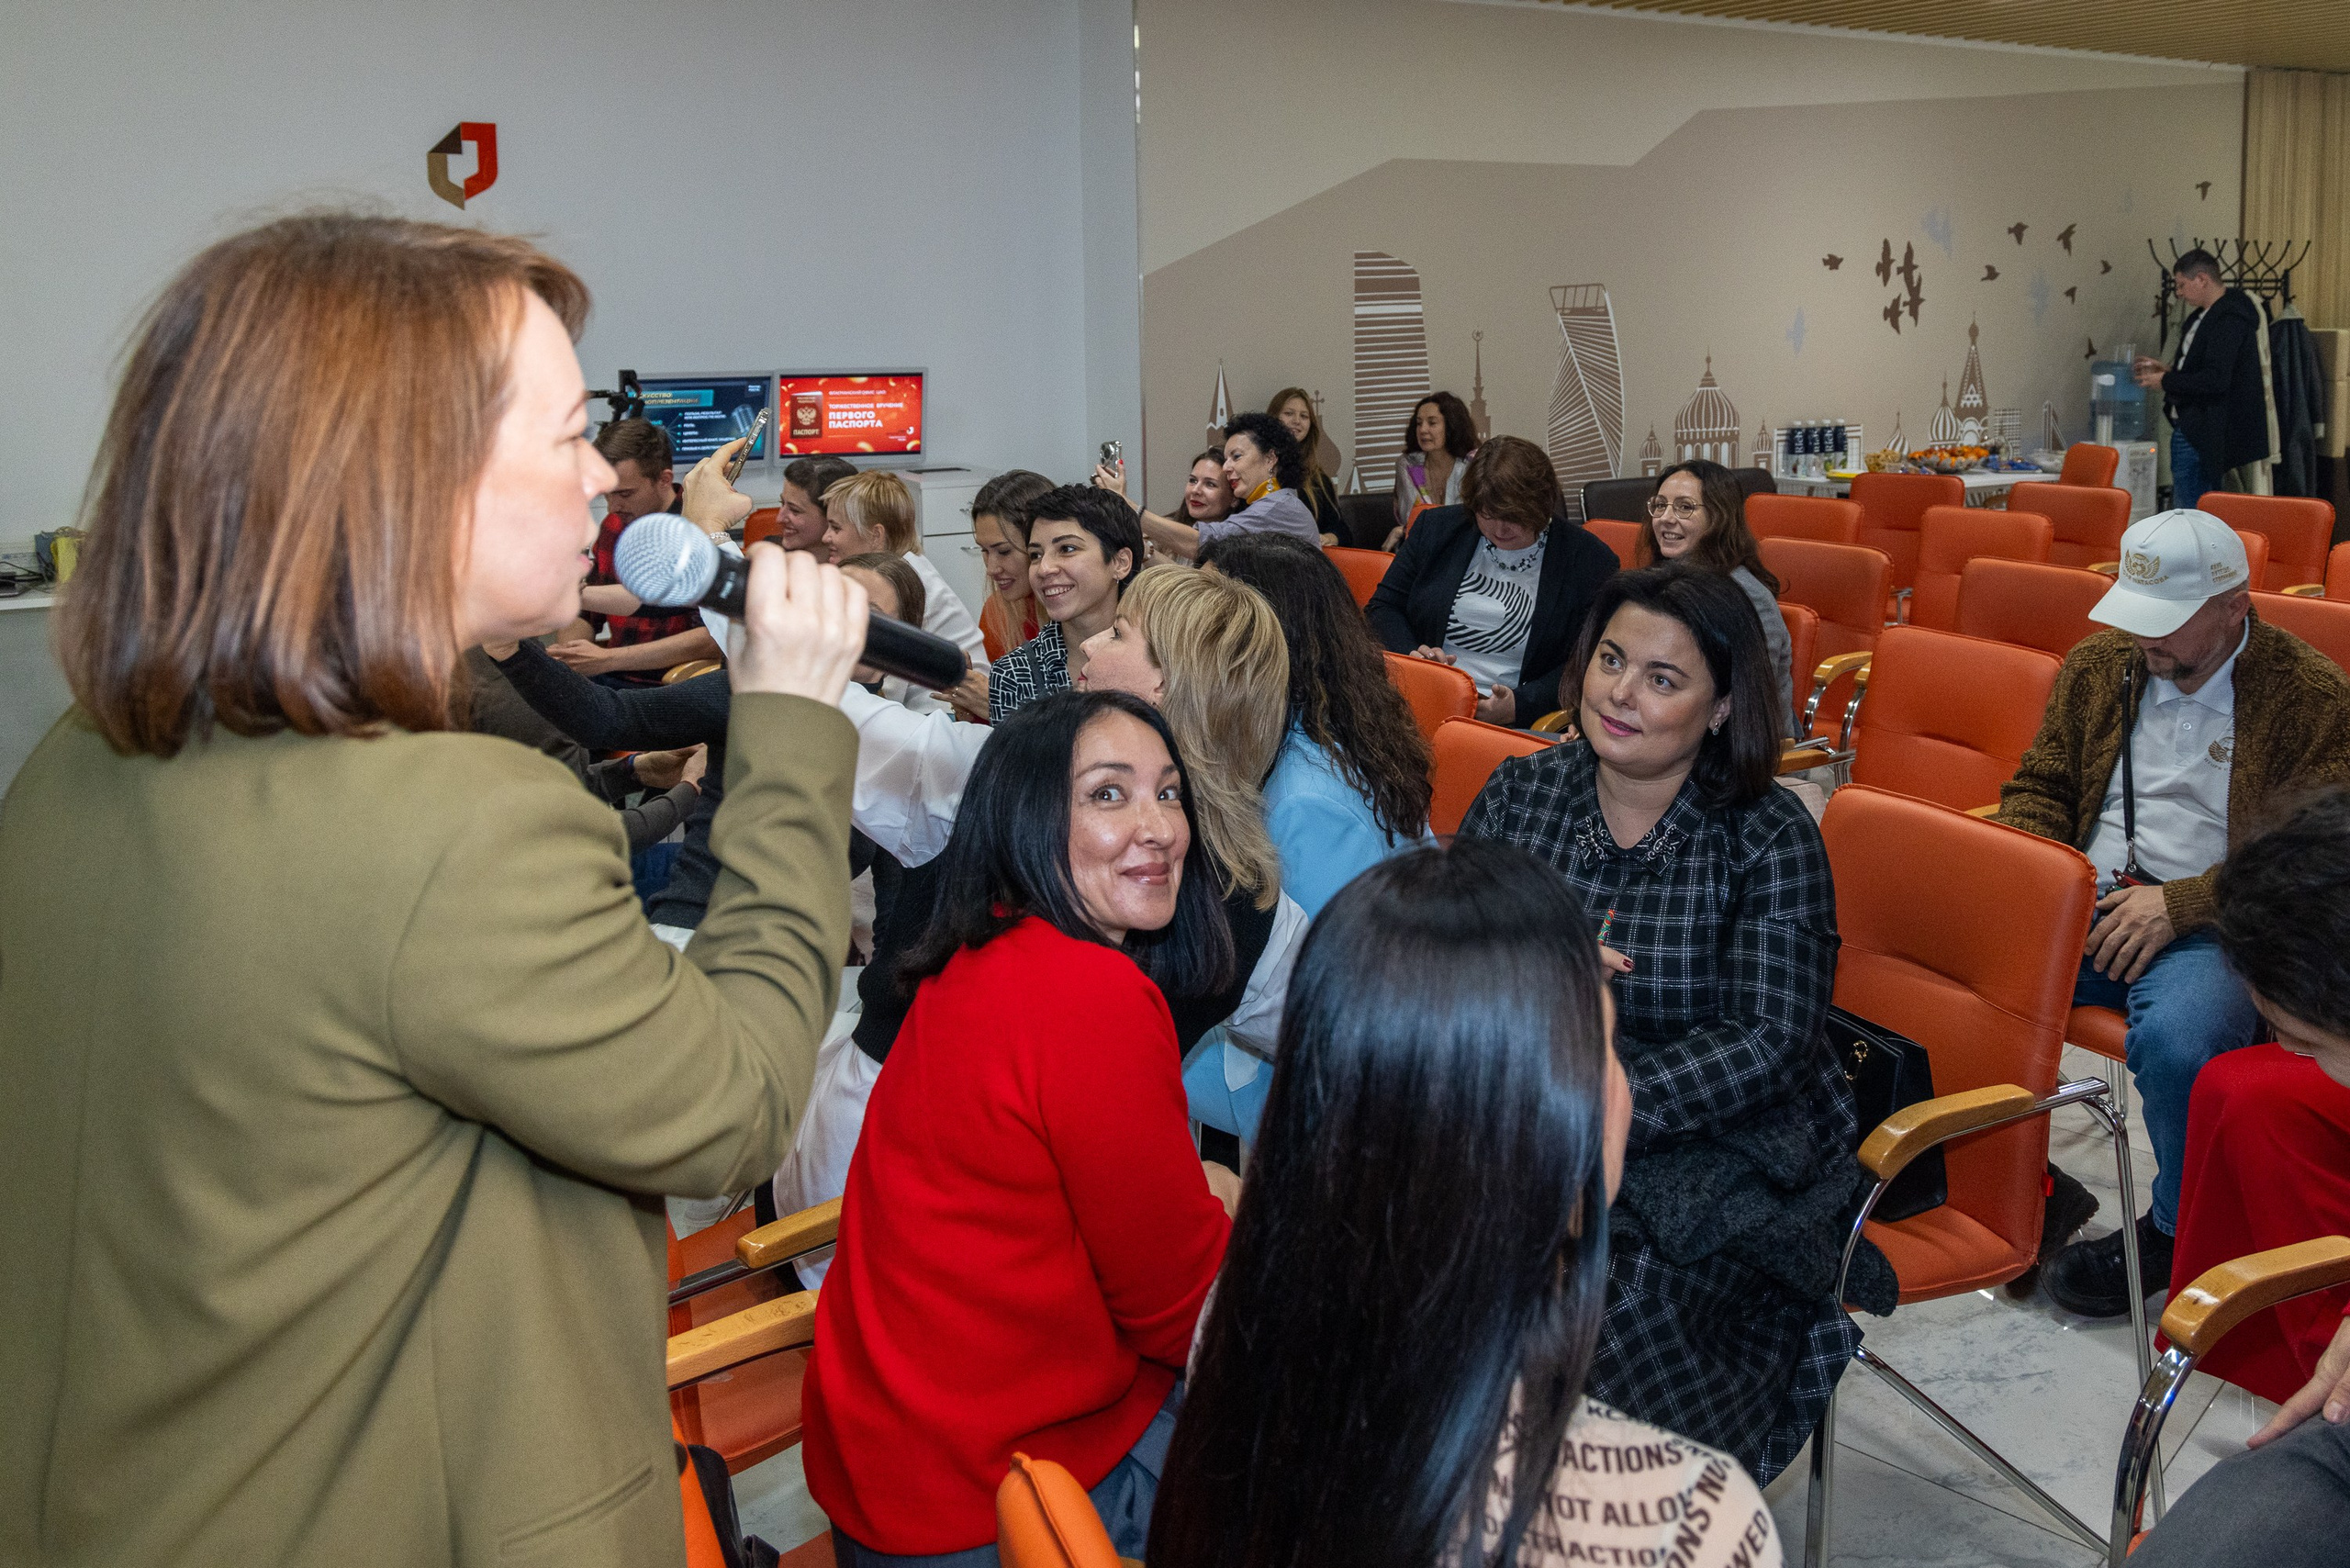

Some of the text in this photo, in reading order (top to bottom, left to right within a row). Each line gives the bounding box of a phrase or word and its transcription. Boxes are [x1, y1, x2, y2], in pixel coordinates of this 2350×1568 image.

[828, 411, 876, 420] ПЕРВОГО
[828, 420, 883, 429] ПАСПОРТА
[1794, 431, 1804, 454] Rich
[1825, 430, 1834, 452] Rich
[1561, 1439, 1684, 1475] ACTIONS
